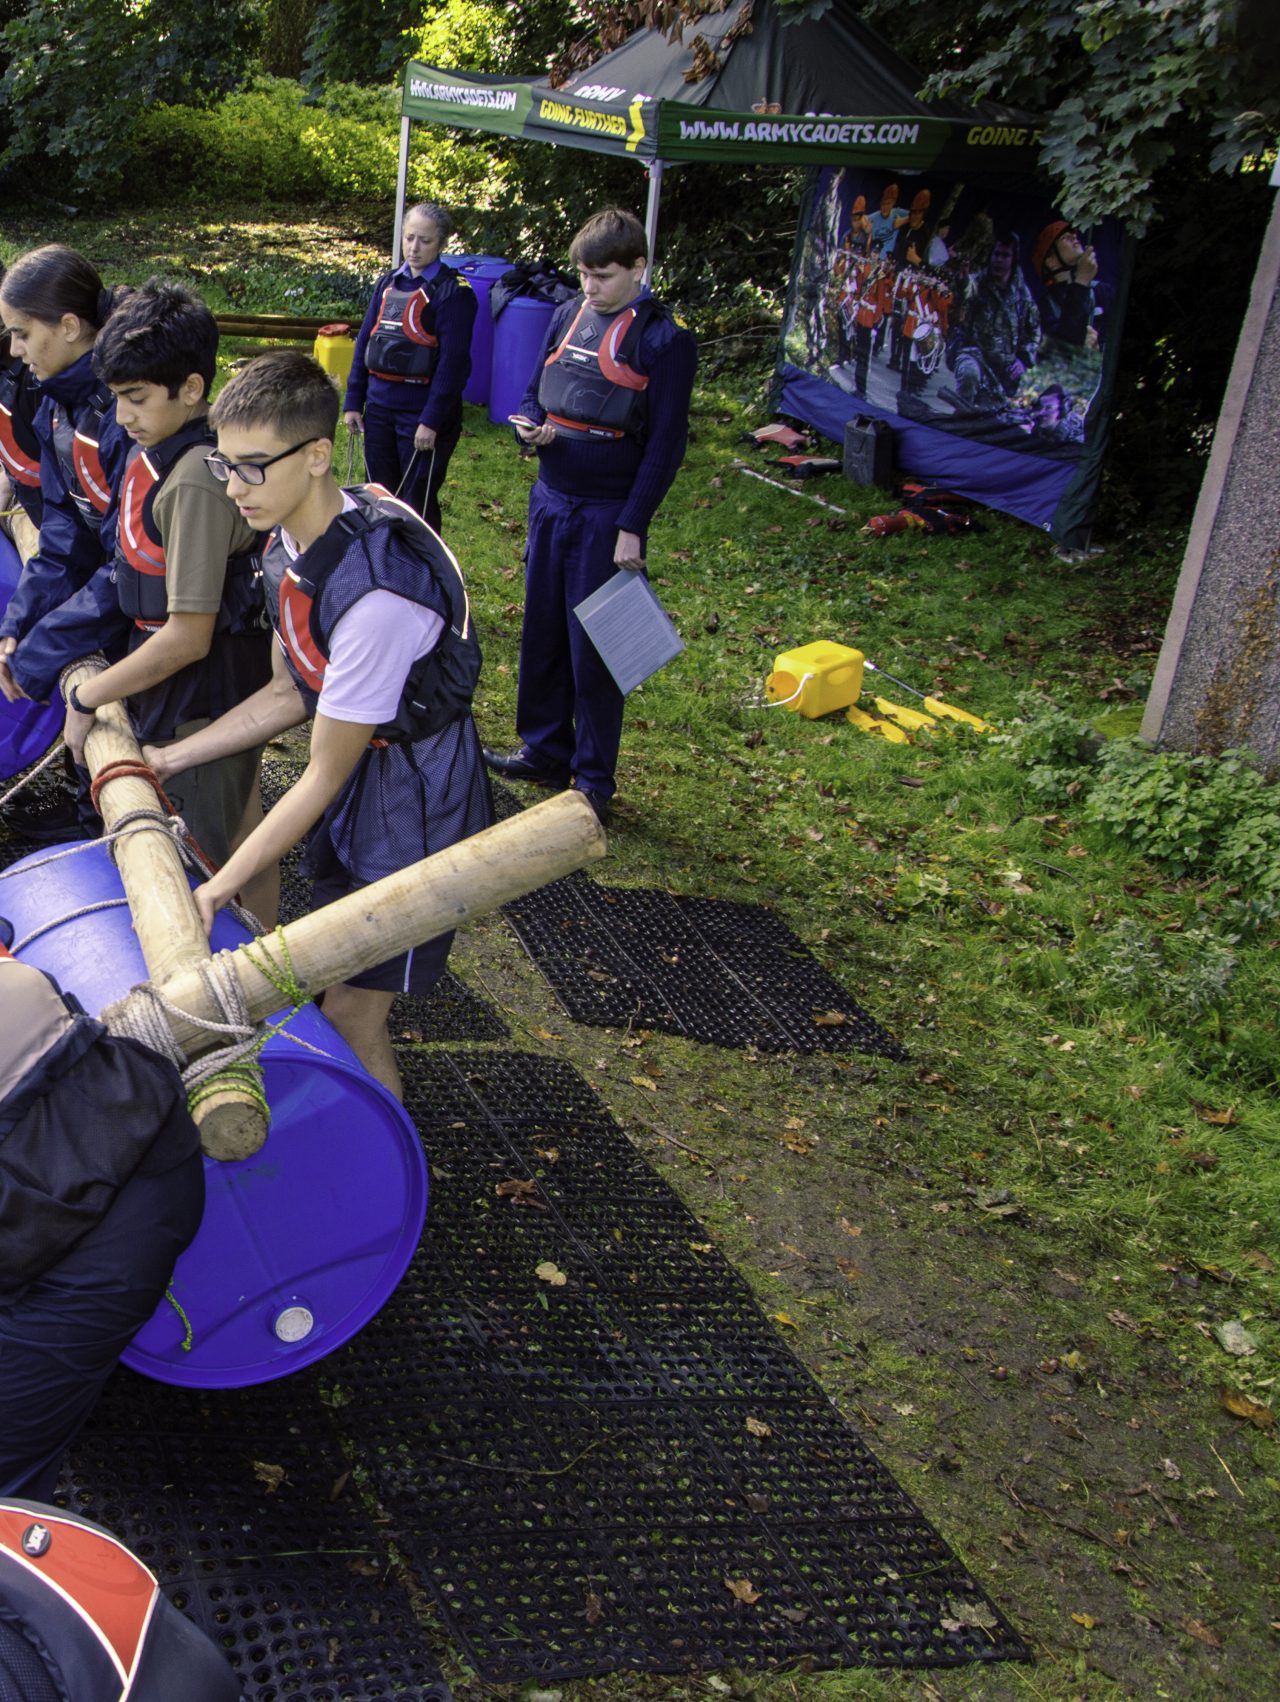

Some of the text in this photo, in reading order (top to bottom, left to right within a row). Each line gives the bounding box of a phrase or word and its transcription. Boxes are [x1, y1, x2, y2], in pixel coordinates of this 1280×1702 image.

[410, 79, 517, 111] WWW.ARMYCADETS.COM
[539, 99, 627, 136] GOING FURTHER
[680, 120, 920, 144] WWW.ARMYCADETS.COM
[966, 126, 1026, 146] GOING
